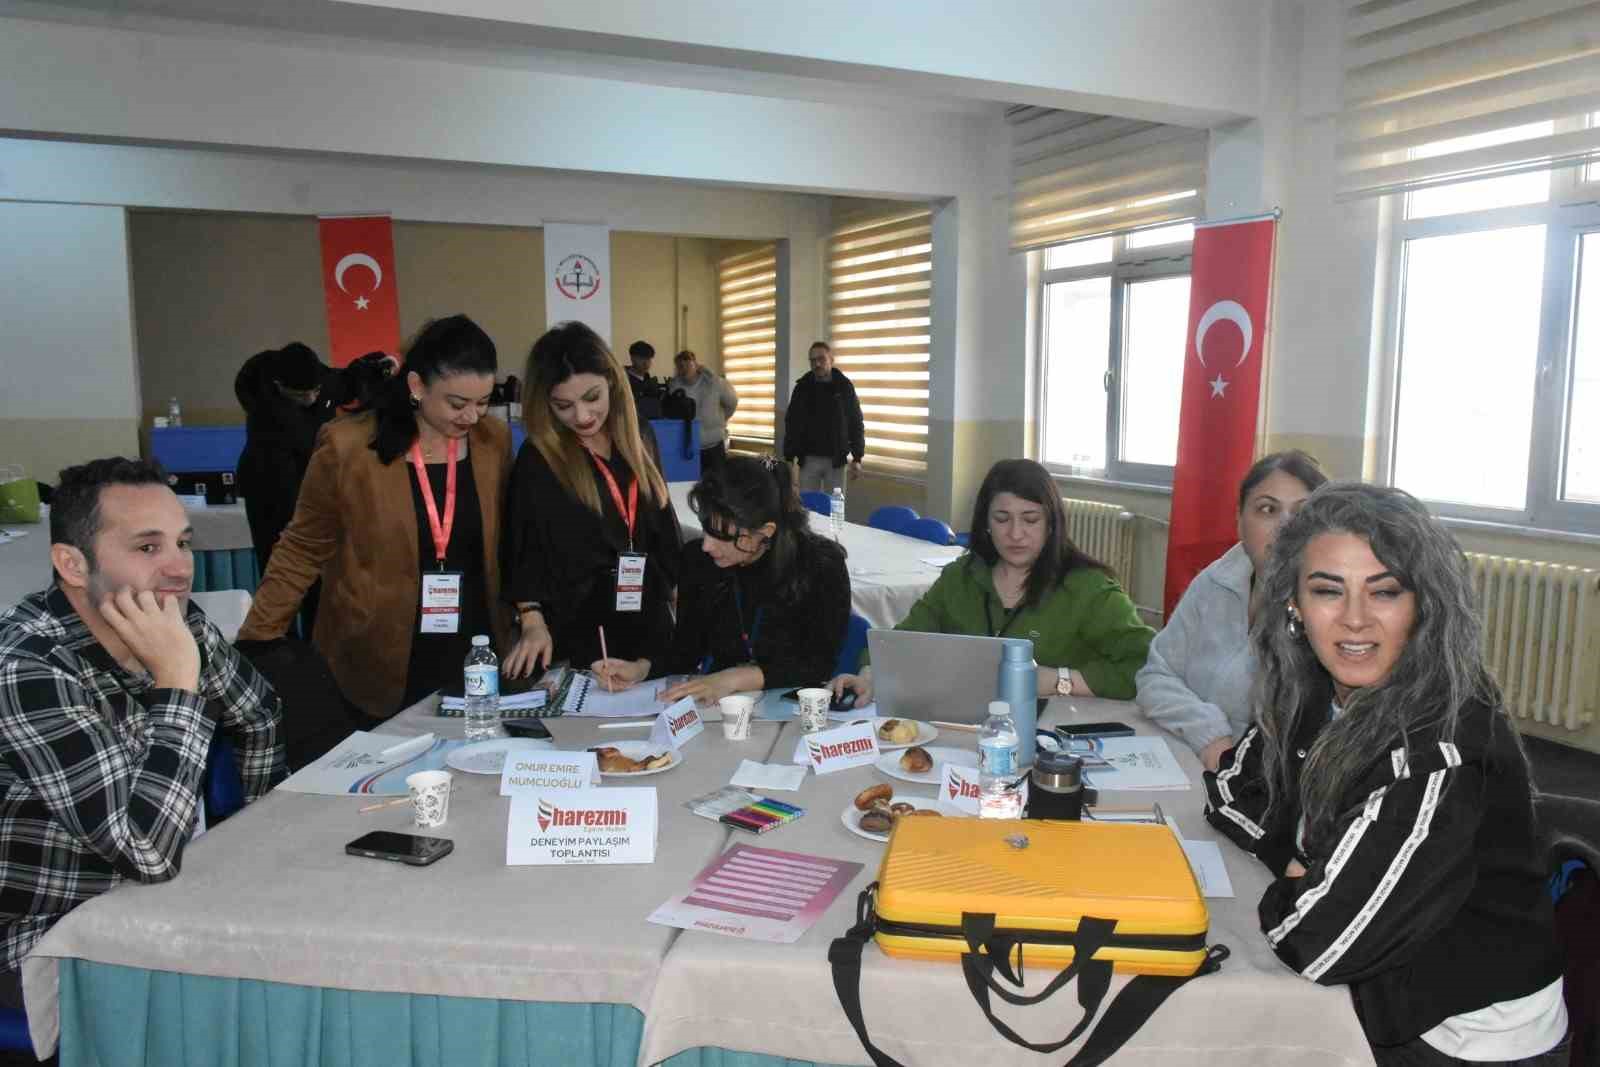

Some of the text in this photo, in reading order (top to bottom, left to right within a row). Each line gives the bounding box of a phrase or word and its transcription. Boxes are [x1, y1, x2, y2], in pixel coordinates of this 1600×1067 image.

[820, 737, 873, 759] harezmi
[516, 762, 580, 774] ONUR EMRE
[552, 807, 627, 826] harezmi
[530, 836, 630, 848] DENEYİM PAYLAŞIM
[550, 849, 610, 858] TOPLANTISI
